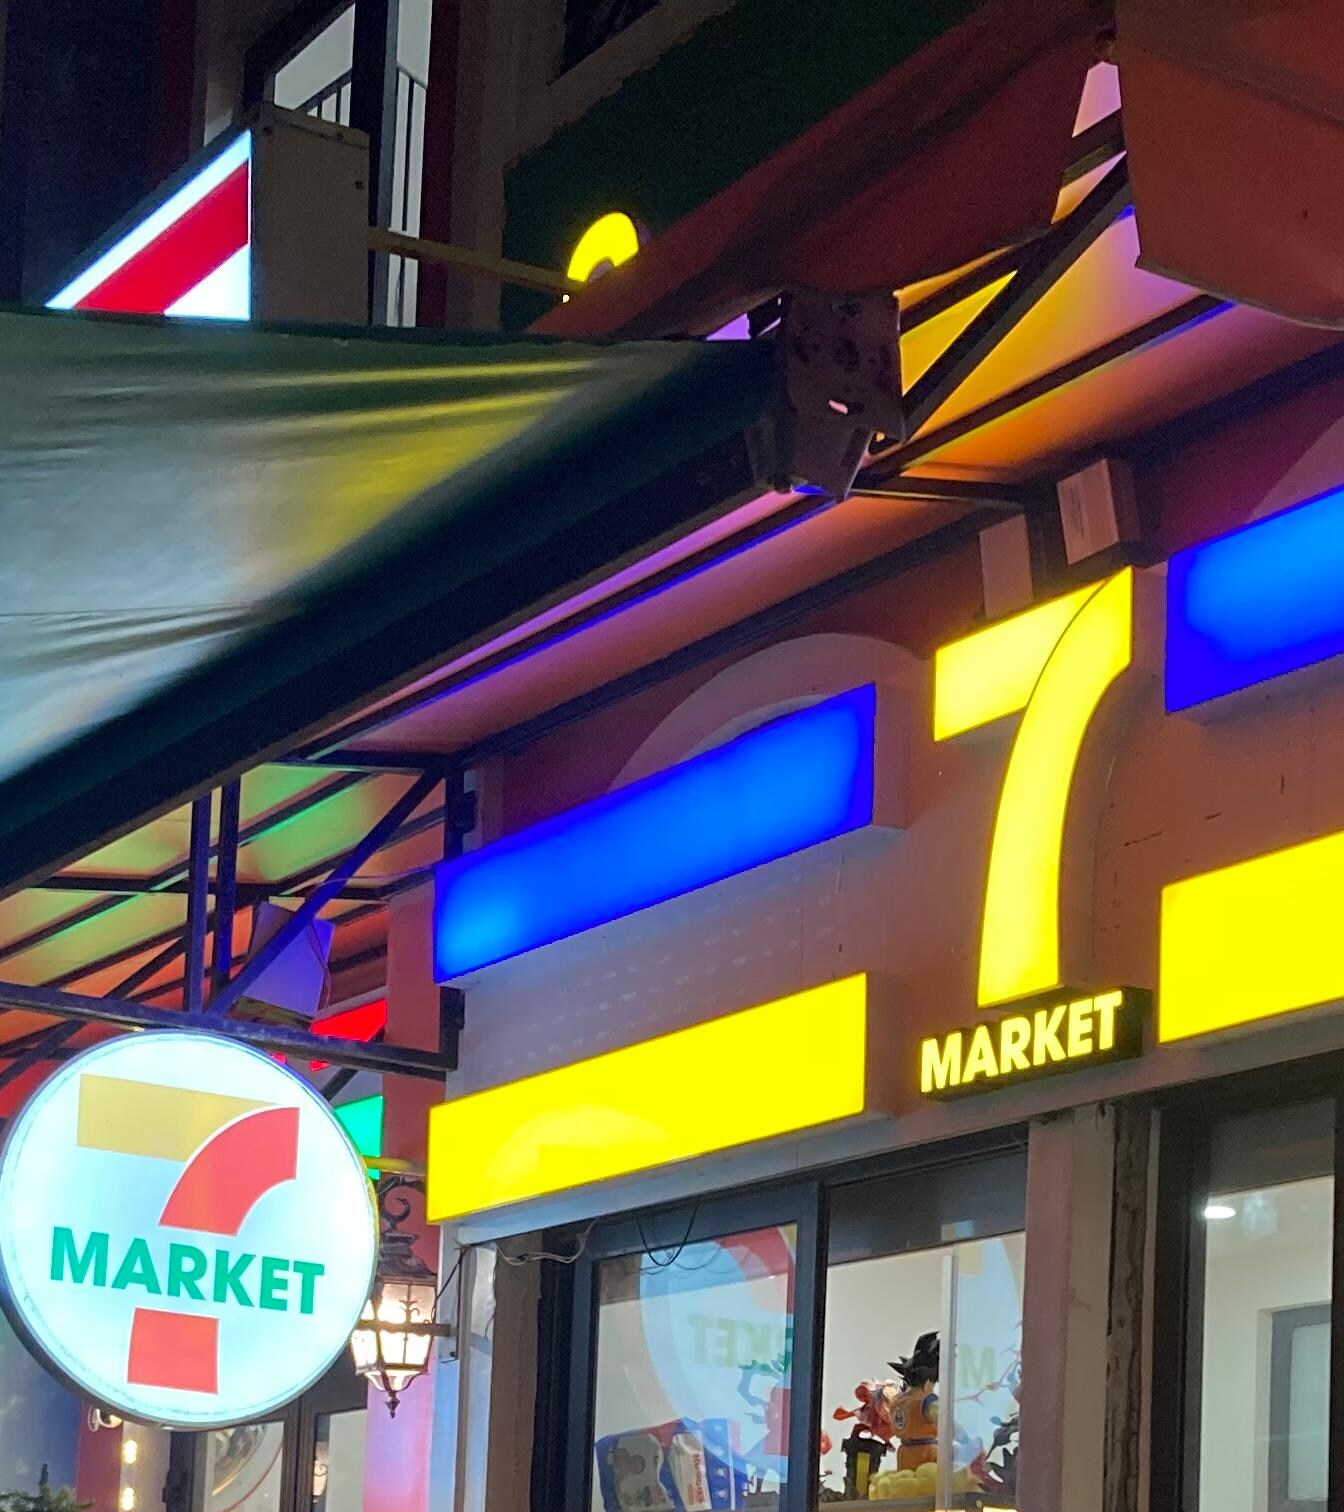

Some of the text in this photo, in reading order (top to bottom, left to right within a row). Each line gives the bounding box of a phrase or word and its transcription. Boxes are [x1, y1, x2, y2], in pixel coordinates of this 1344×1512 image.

[934, 565, 1133, 1008] 7
[920, 991, 1123, 1094] MARKET
[50, 1226, 325, 1315] MARKET
